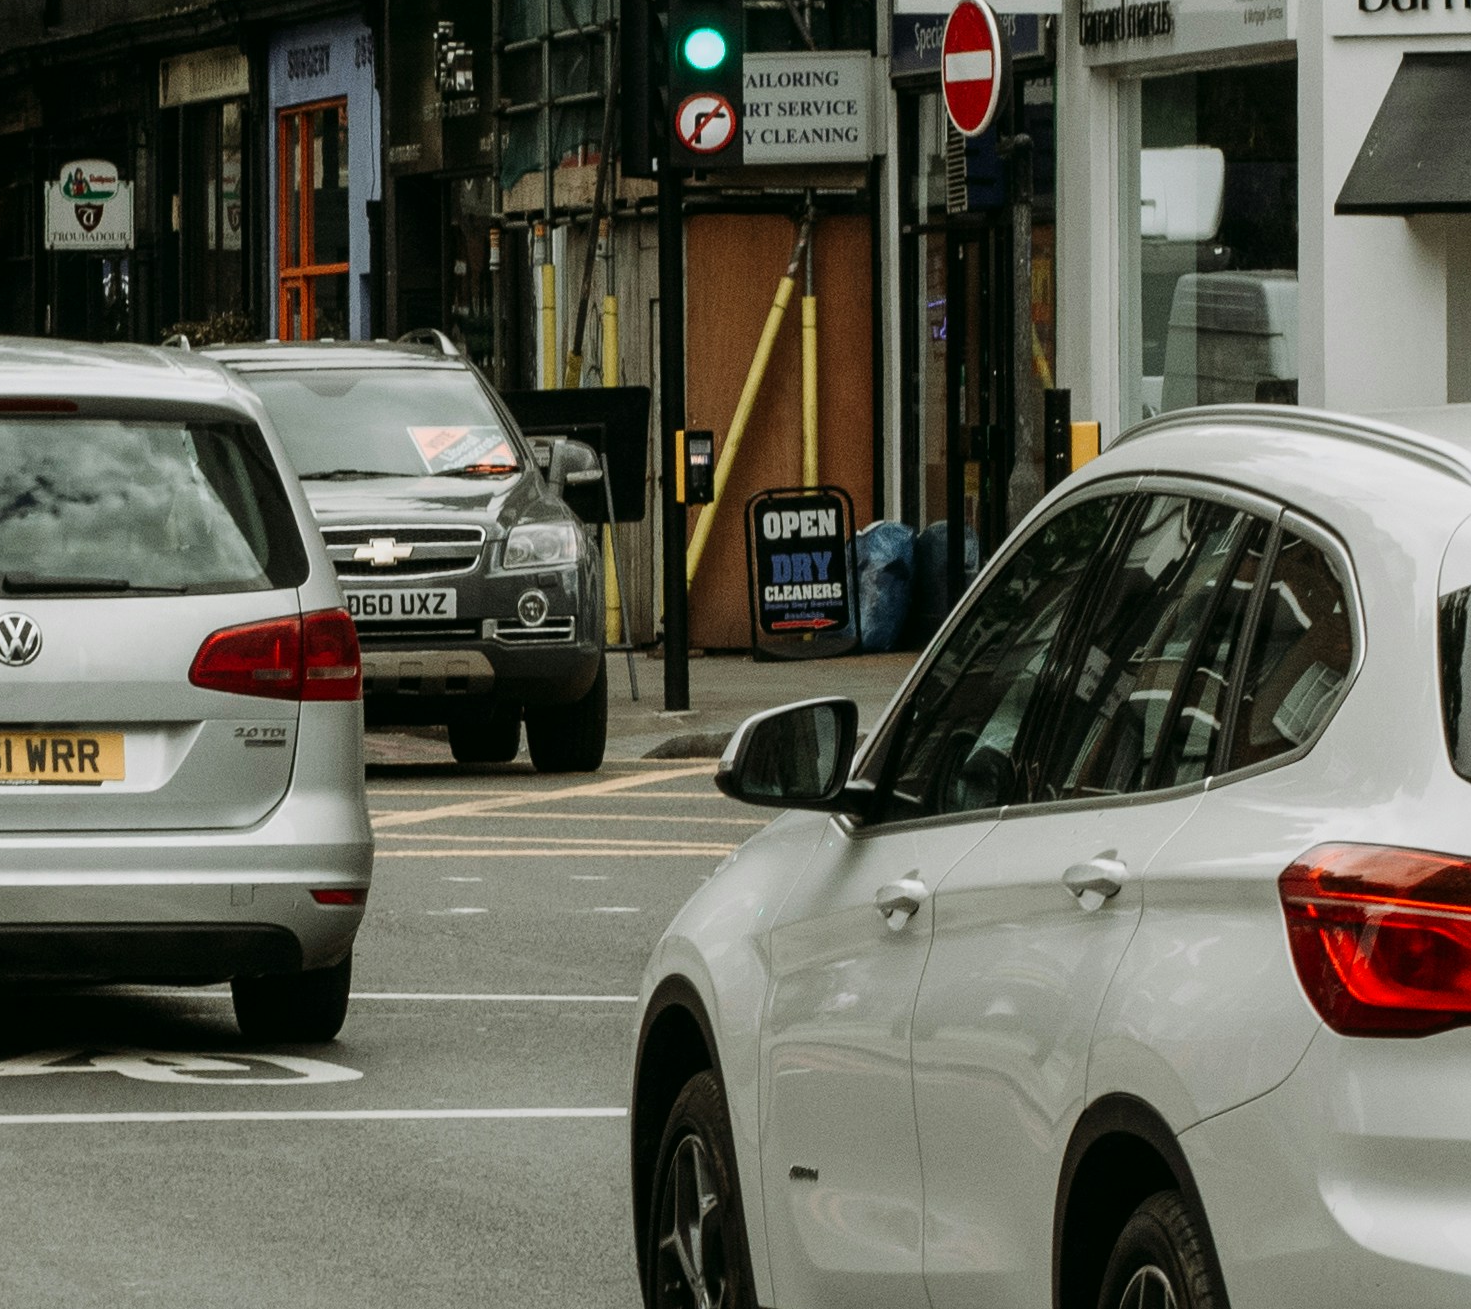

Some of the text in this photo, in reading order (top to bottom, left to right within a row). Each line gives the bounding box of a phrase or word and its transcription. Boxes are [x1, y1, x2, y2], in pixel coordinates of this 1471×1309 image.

[914, 16, 948, 59] Specia
[743, 71, 839, 89] AILORING
[743, 99, 858, 118] IRT SERVICE
[760, 127, 859, 145] CLEANING
[762, 508, 837, 540] OPEN
[771, 551, 832, 583] DRY
[764, 583, 842, 602] CLEANERS
[346, 593, 447, 616] D60 UXZ
[234, 727, 287, 739] 2.0 TDI
[26, 738, 101, 774] WRR
